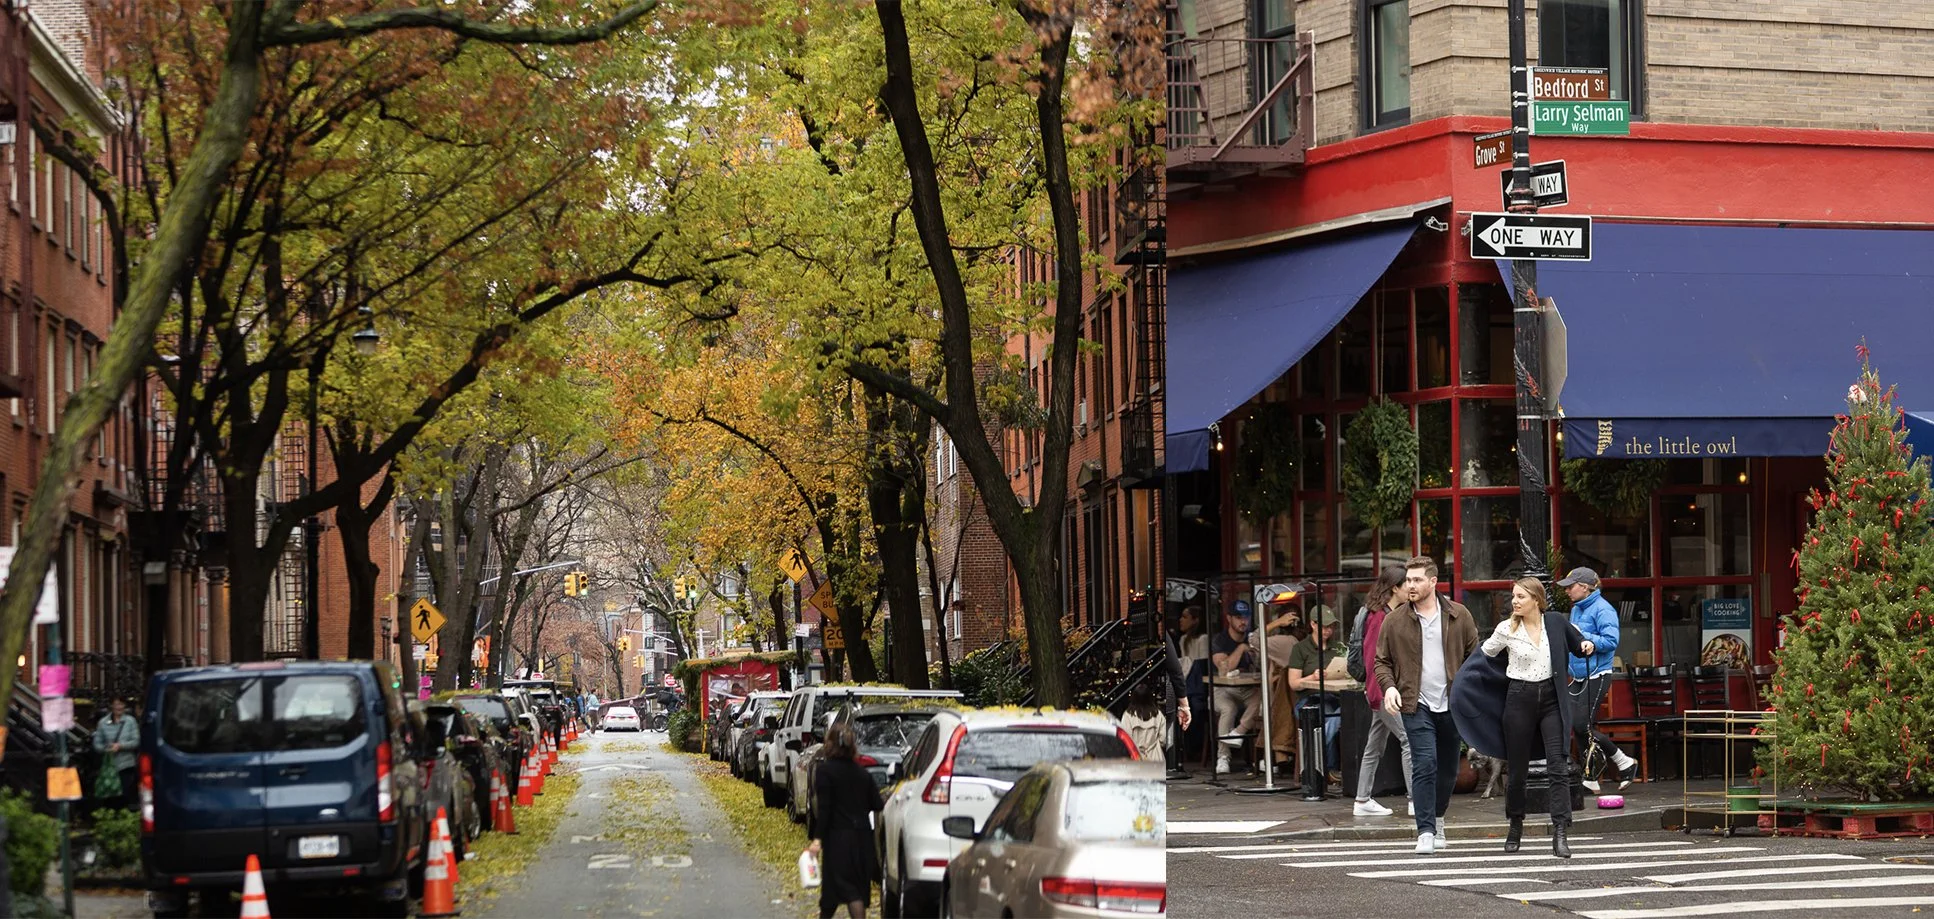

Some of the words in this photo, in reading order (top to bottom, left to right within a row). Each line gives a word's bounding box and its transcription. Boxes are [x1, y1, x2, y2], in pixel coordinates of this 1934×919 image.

[1534, 76, 1589, 98] Bedford
[1594, 78, 1605, 91] St
[1535, 104, 1569, 126] Larry
[1573, 104, 1624, 122] Selman
[1571, 123, 1589, 134] Way
[1475, 145, 1497, 166] Grove
[1499, 140, 1505, 154] St
[1537, 175, 1557, 194] WAY
[1490, 228, 1524, 244] ONE
[1540, 229, 1575, 246] WAY
[1625, 436, 1652, 455] the
[1659, 436, 1700, 455] little
[1706, 436, 1737, 455] owl
[826, 629, 845, 640] 20
[587, 853, 693, 869] 20
